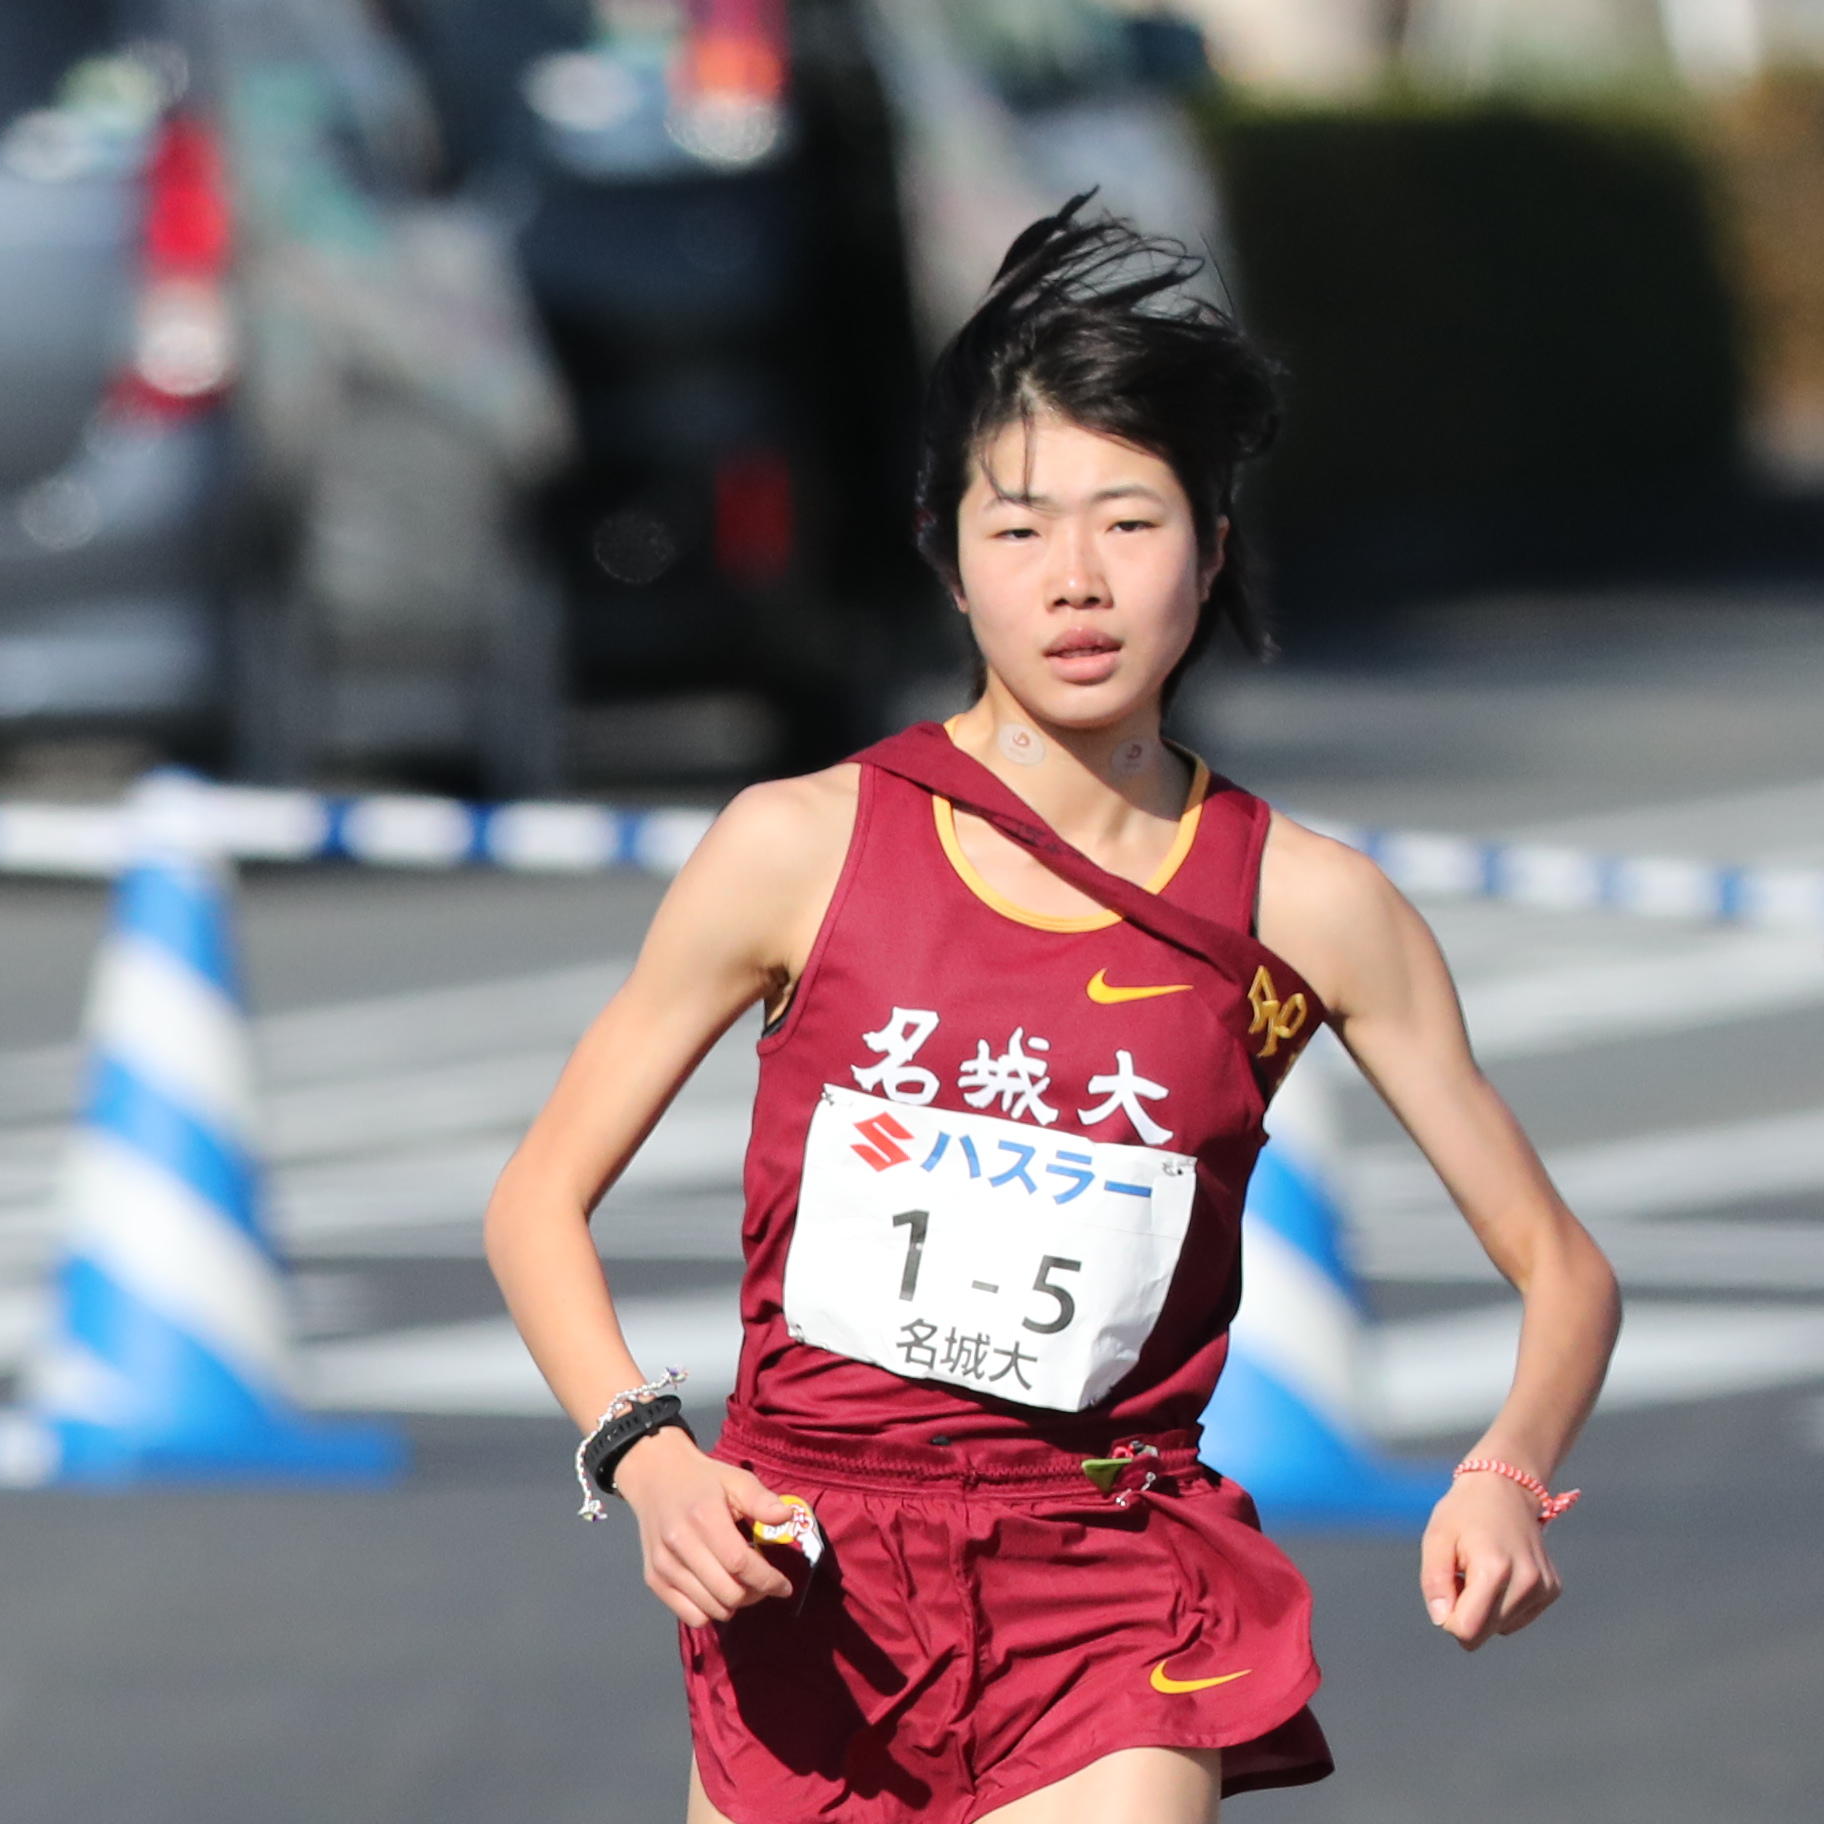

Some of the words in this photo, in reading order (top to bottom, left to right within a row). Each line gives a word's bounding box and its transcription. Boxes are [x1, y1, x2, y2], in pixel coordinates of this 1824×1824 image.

[850, 1006, 1174, 1146] 名城大
[919, 1130, 1153, 1205] ハスラー
[895, 1317, 1039, 1391] 名城大
